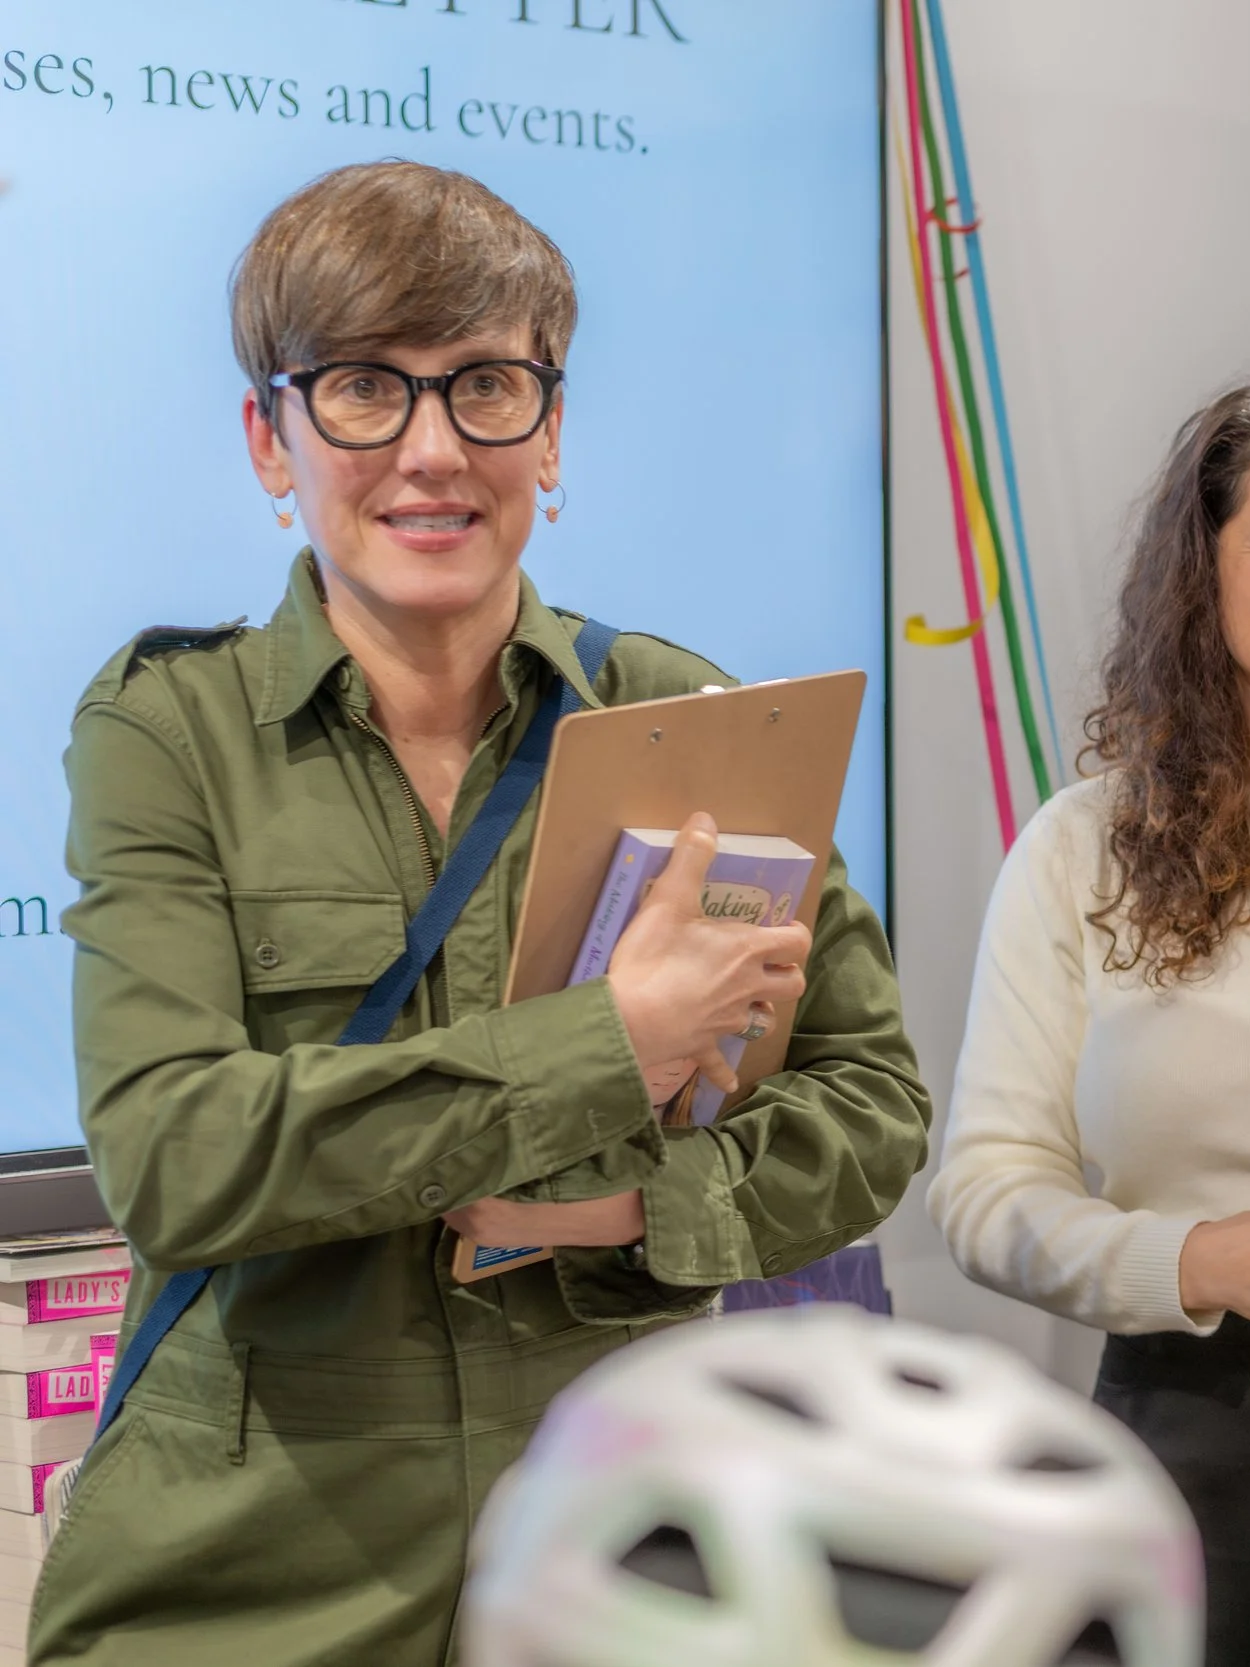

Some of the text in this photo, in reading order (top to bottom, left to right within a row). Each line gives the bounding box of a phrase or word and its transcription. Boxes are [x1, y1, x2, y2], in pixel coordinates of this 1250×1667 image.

[138, 64, 300, 119] news
[326, 65, 437, 133] and
[457, 98, 649, 155] events.
[701, 892, 763, 920] aking
[54, 1279, 121, 1304] LADY'S
[55, 1375, 90, 1399] LAD
